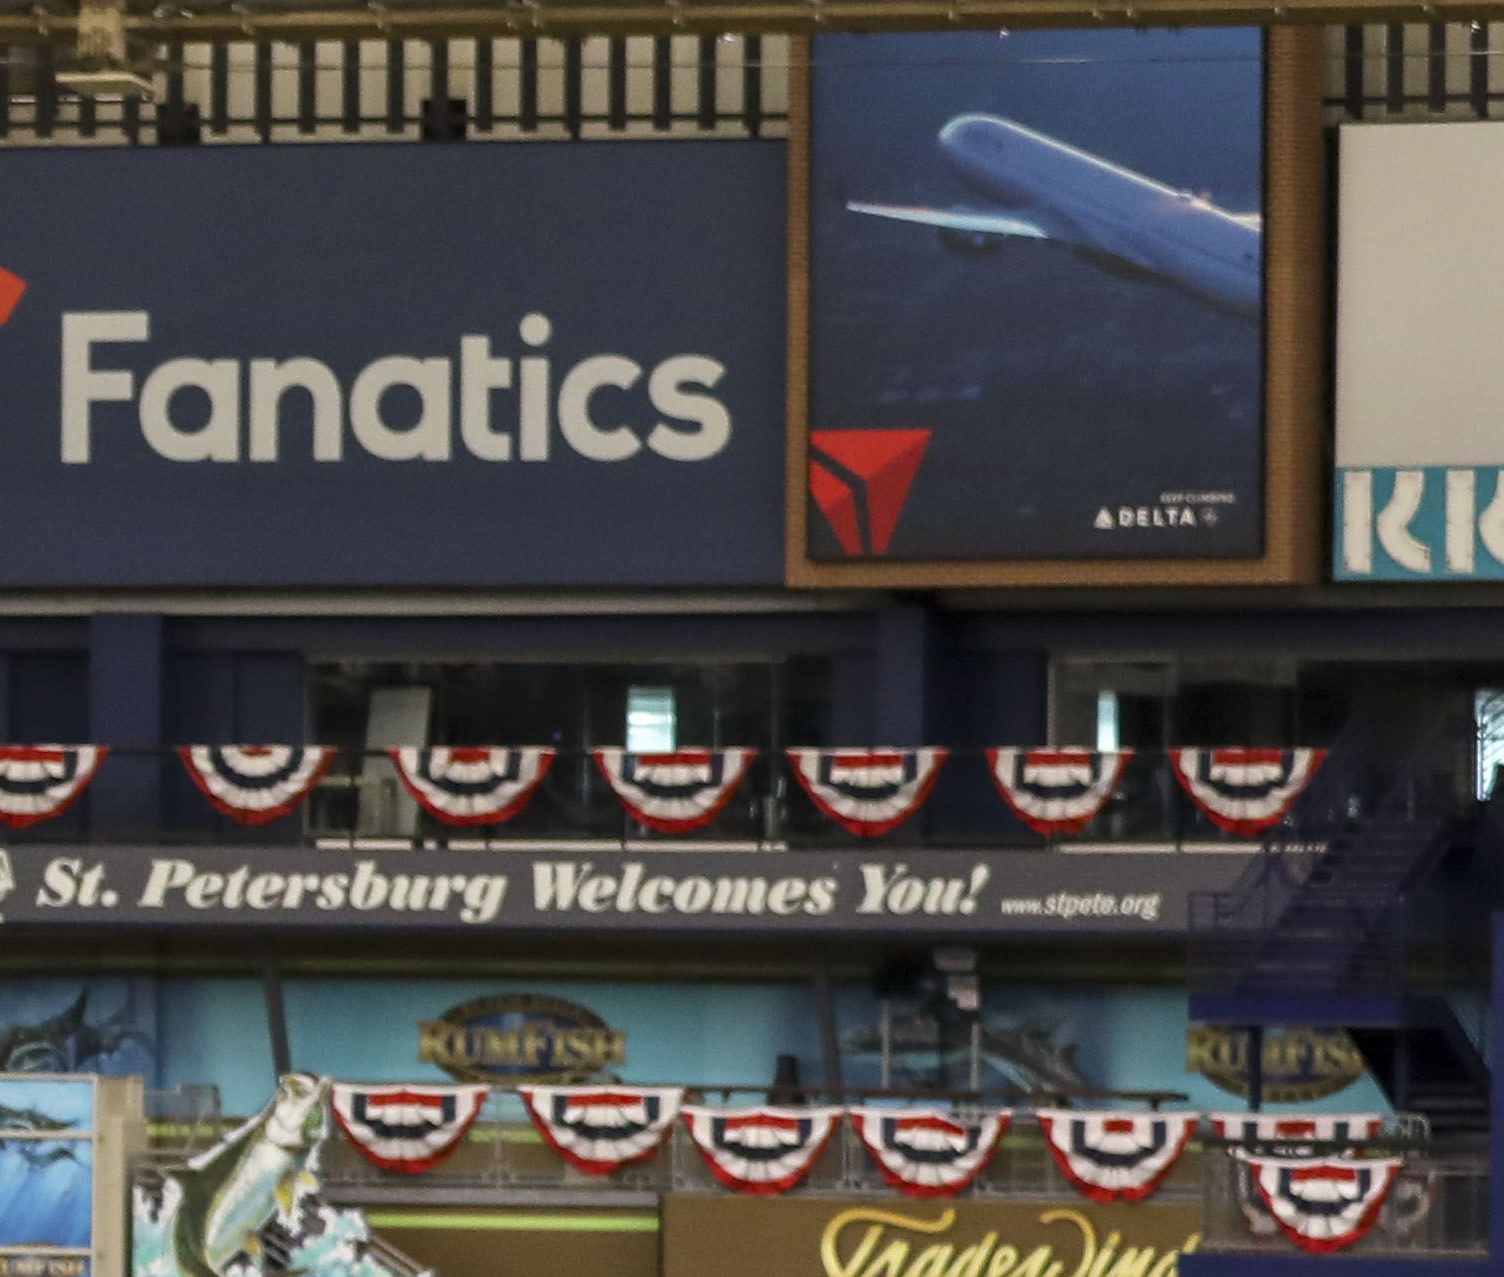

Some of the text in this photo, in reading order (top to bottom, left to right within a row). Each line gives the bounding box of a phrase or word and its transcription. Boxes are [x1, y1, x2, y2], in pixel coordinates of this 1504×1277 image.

[60, 311, 732, 464] Fanatics
[1118, 507, 1197, 527] DELTA
[36, 859, 118, 908] St.
[138, 859, 505, 924] Petersburg
[532, 862, 836, 915] Welcomes
[857, 864, 990, 915] You!
